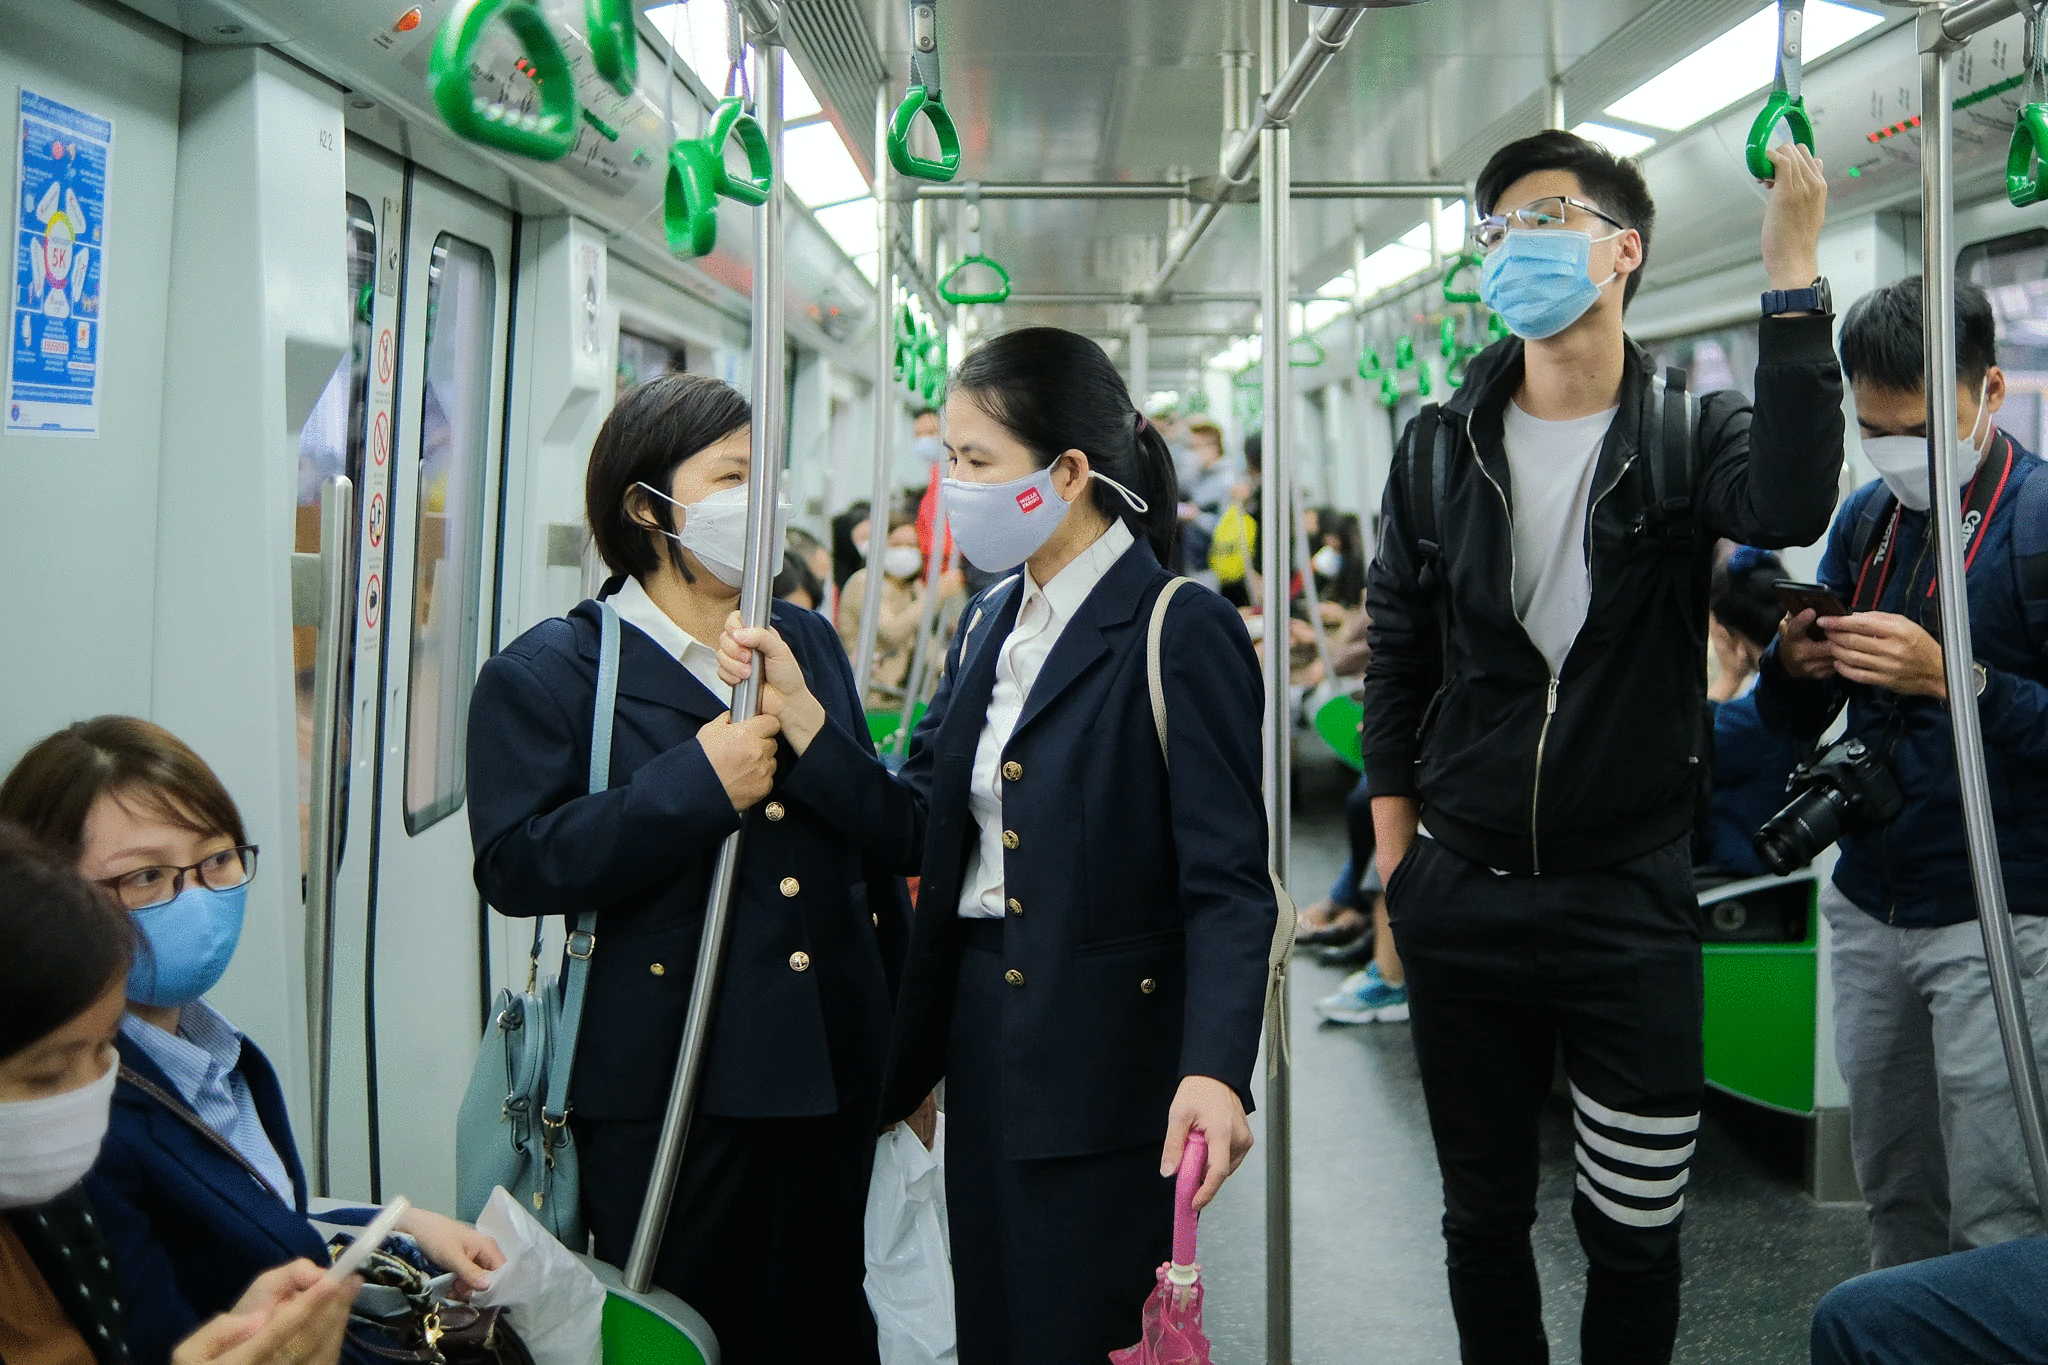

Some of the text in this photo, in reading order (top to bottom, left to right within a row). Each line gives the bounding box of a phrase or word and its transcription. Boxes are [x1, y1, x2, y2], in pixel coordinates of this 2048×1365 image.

[52, 247, 67, 269] 5K
[1022, 496, 1040, 509] FARGO
[1961, 509, 1982, 551] Can
